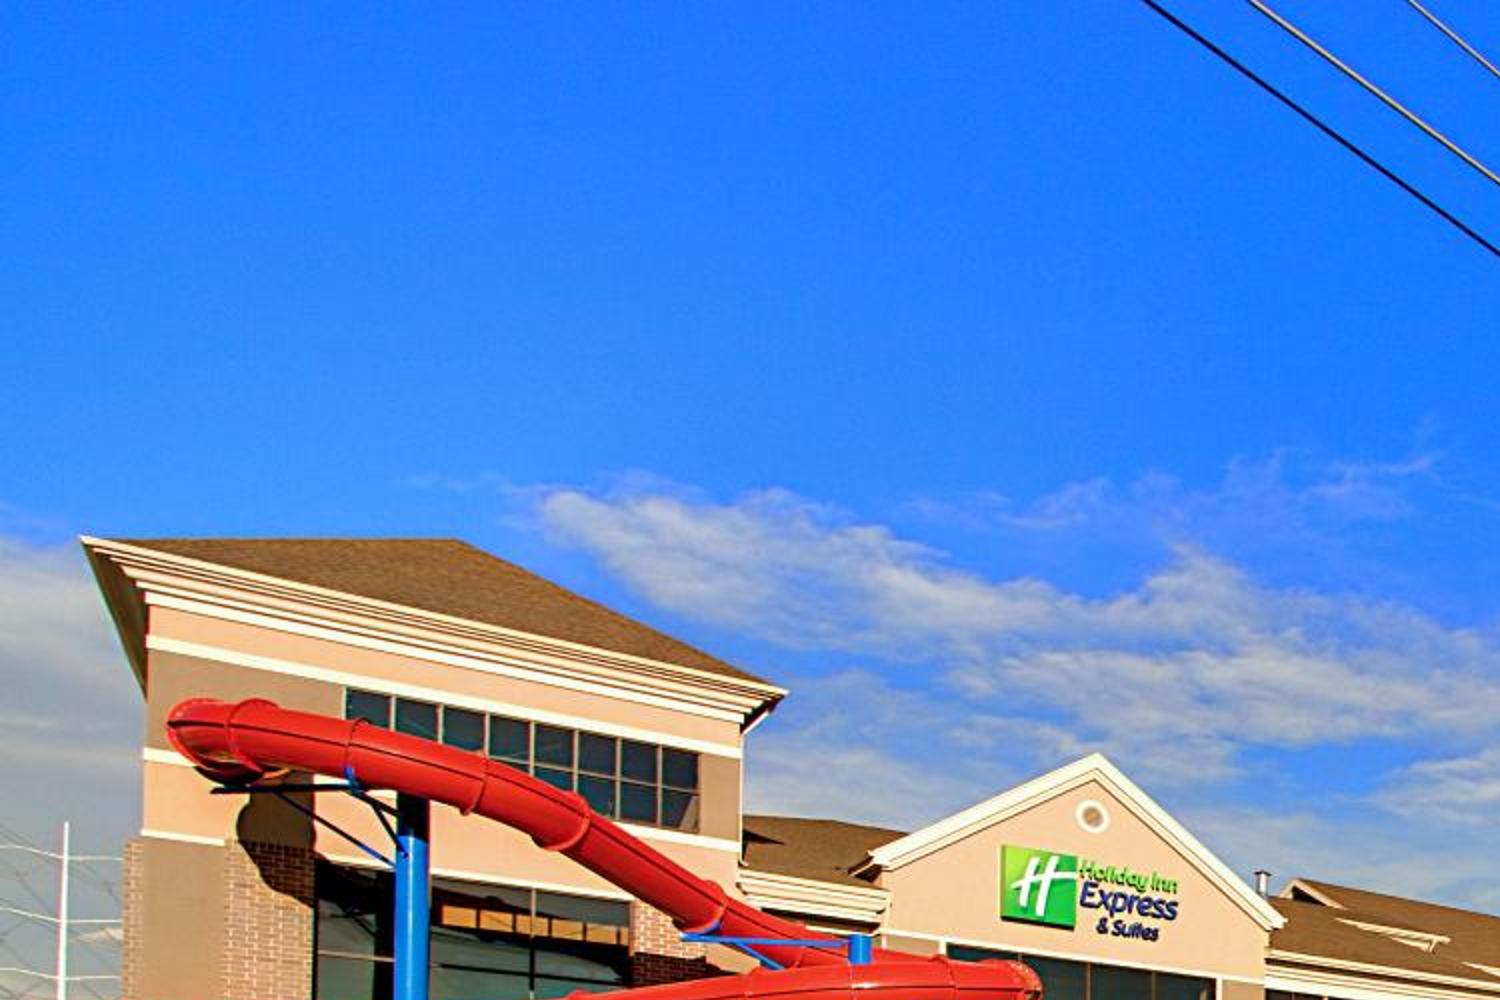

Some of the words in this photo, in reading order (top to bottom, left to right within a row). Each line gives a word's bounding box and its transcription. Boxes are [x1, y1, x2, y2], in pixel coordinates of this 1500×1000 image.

[1079, 860, 1150, 893] Holiday
[1079, 880, 1179, 921] Express
[1095, 917, 1109, 935] &
[1110, 919, 1159, 942] Suites
